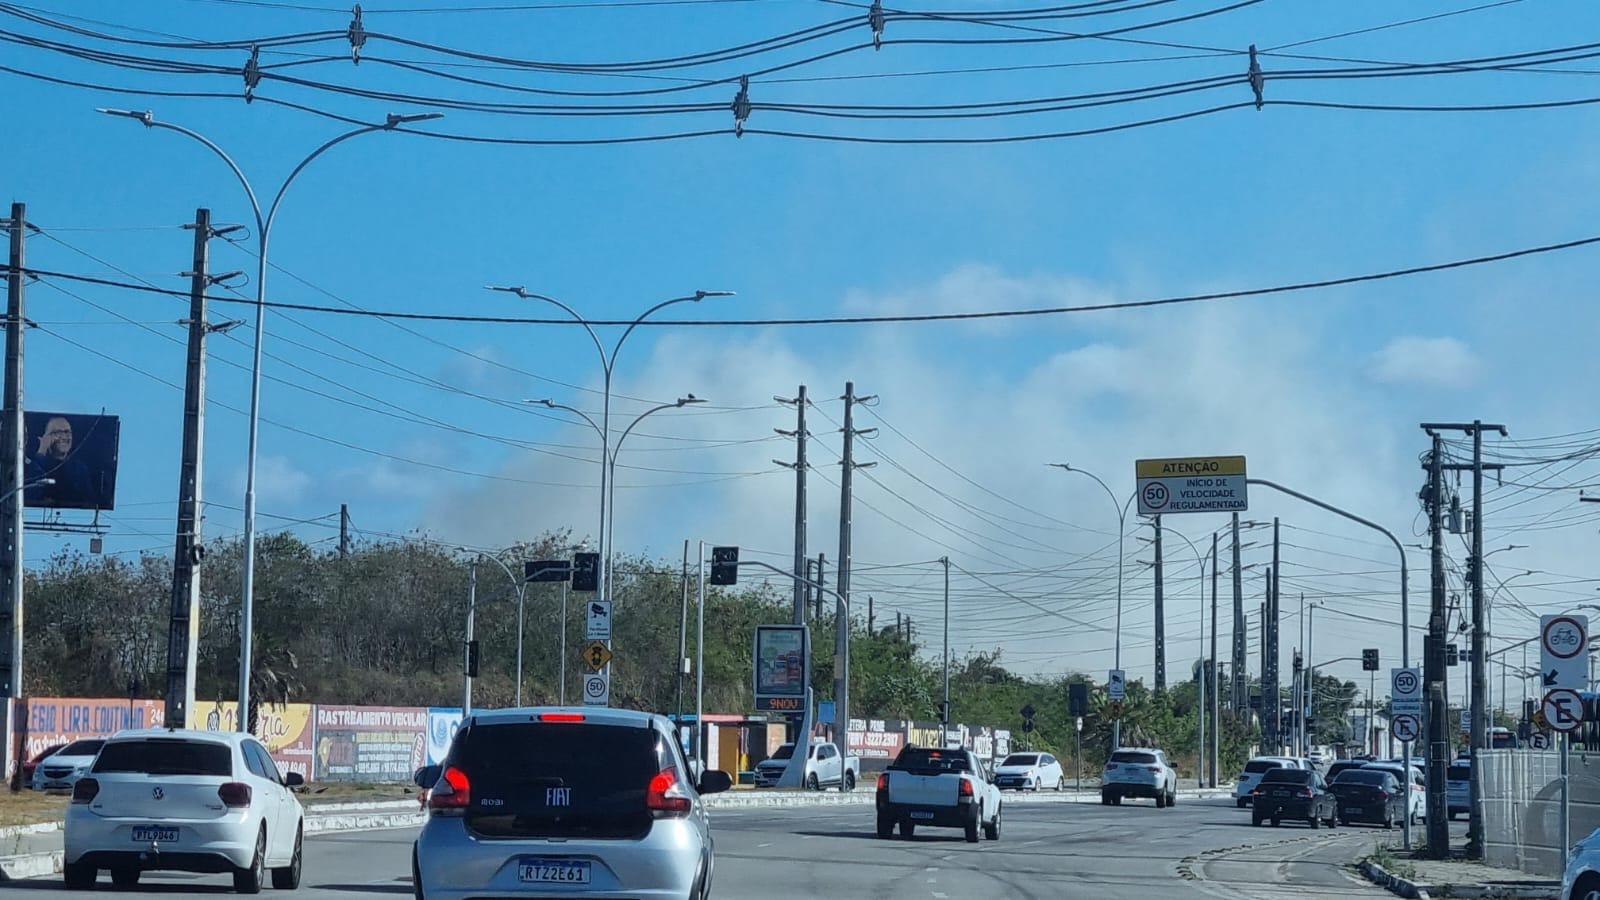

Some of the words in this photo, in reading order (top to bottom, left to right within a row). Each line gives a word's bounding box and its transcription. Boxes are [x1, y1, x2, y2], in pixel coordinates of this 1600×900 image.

[1163, 460, 1219, 474] ATENÇÃO
[1186, 478, 1213, 488] INÍCIO
[1215, 479, 1228, 487] DE
[1146, 487, 1165, 501] 50
[1180, 489, 1235, 499] VELOCIDADE
[1170, 500, 1246, 511] REGULAMENTADA
[589, 681, 603, 691] 50
[1398, 676, 1414, 687] 50
[318, 710, 391, 727] RASTREAMENTO
[391, 711, 427, 727] VEICULAR
[545, 787, 572, 806] FIAT
[525, 866, 583, 882] RTZ2E61
